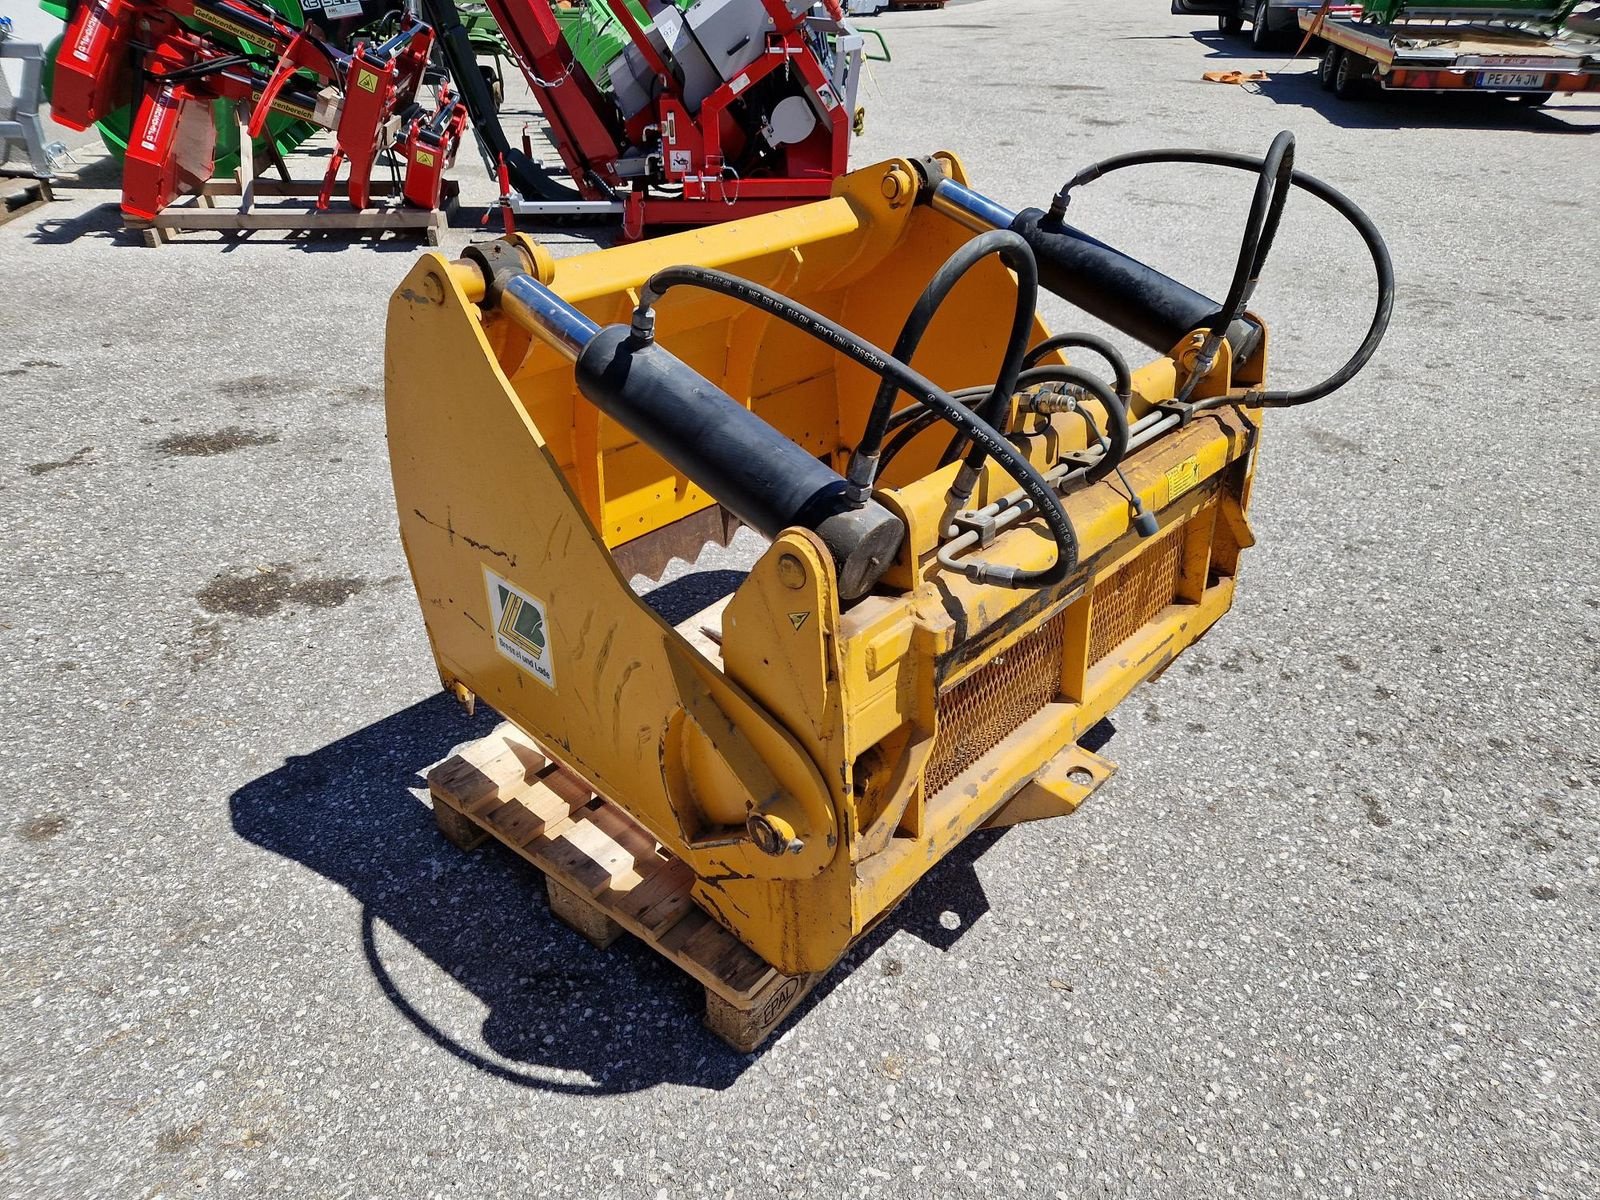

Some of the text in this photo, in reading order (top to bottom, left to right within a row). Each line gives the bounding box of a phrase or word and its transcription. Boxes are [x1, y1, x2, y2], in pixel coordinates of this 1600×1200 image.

[195, 8, 275, 50] Gefahrenbereich 20 M
[1487, 73, 1538, 85] PE 74 JN
[773, 301, 784, 310] EN
[798, 314, 810, 324] HD
[813, 322, 833, 338] LADE
[851, 343, 886, 369] BRESSEL
[971, 425, 989, 443] BAR
[987, 439, 1003, 454] 275
[1000, 453, 1014, 466] WP
[1019, 470, 1029, 480] 12
[1029, 481, 1045, 498] 2SN
[1063, 534, 1073, 544] HD
[498, 637, 551, 680] Bressel und Lade
[762, 988, 794, 1024] EPAL
